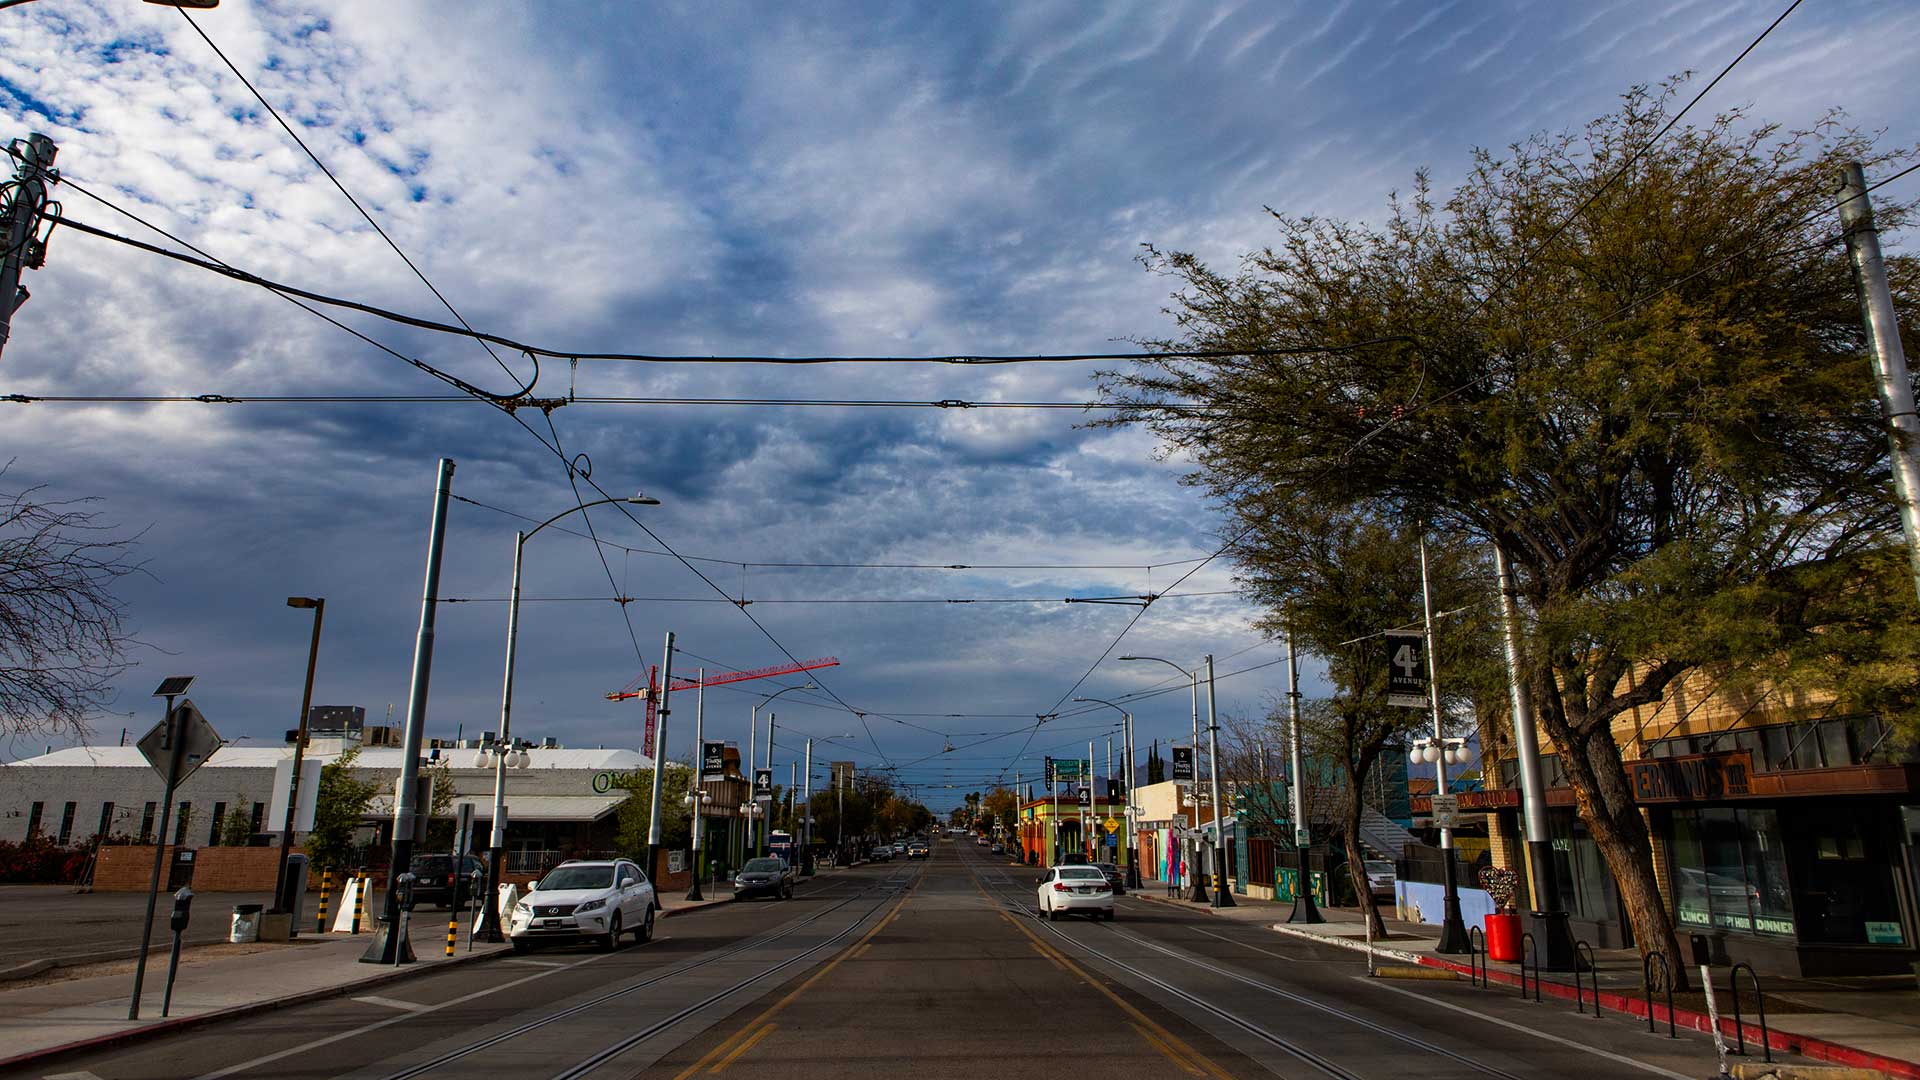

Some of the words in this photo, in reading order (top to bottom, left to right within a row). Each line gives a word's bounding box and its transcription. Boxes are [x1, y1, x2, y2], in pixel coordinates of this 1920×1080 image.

[1392, 676, 1424, 686] AVENUE
[1680, 911, 1709, 923] LUNCH
[1755, 919, 1793, 933] DINNER
